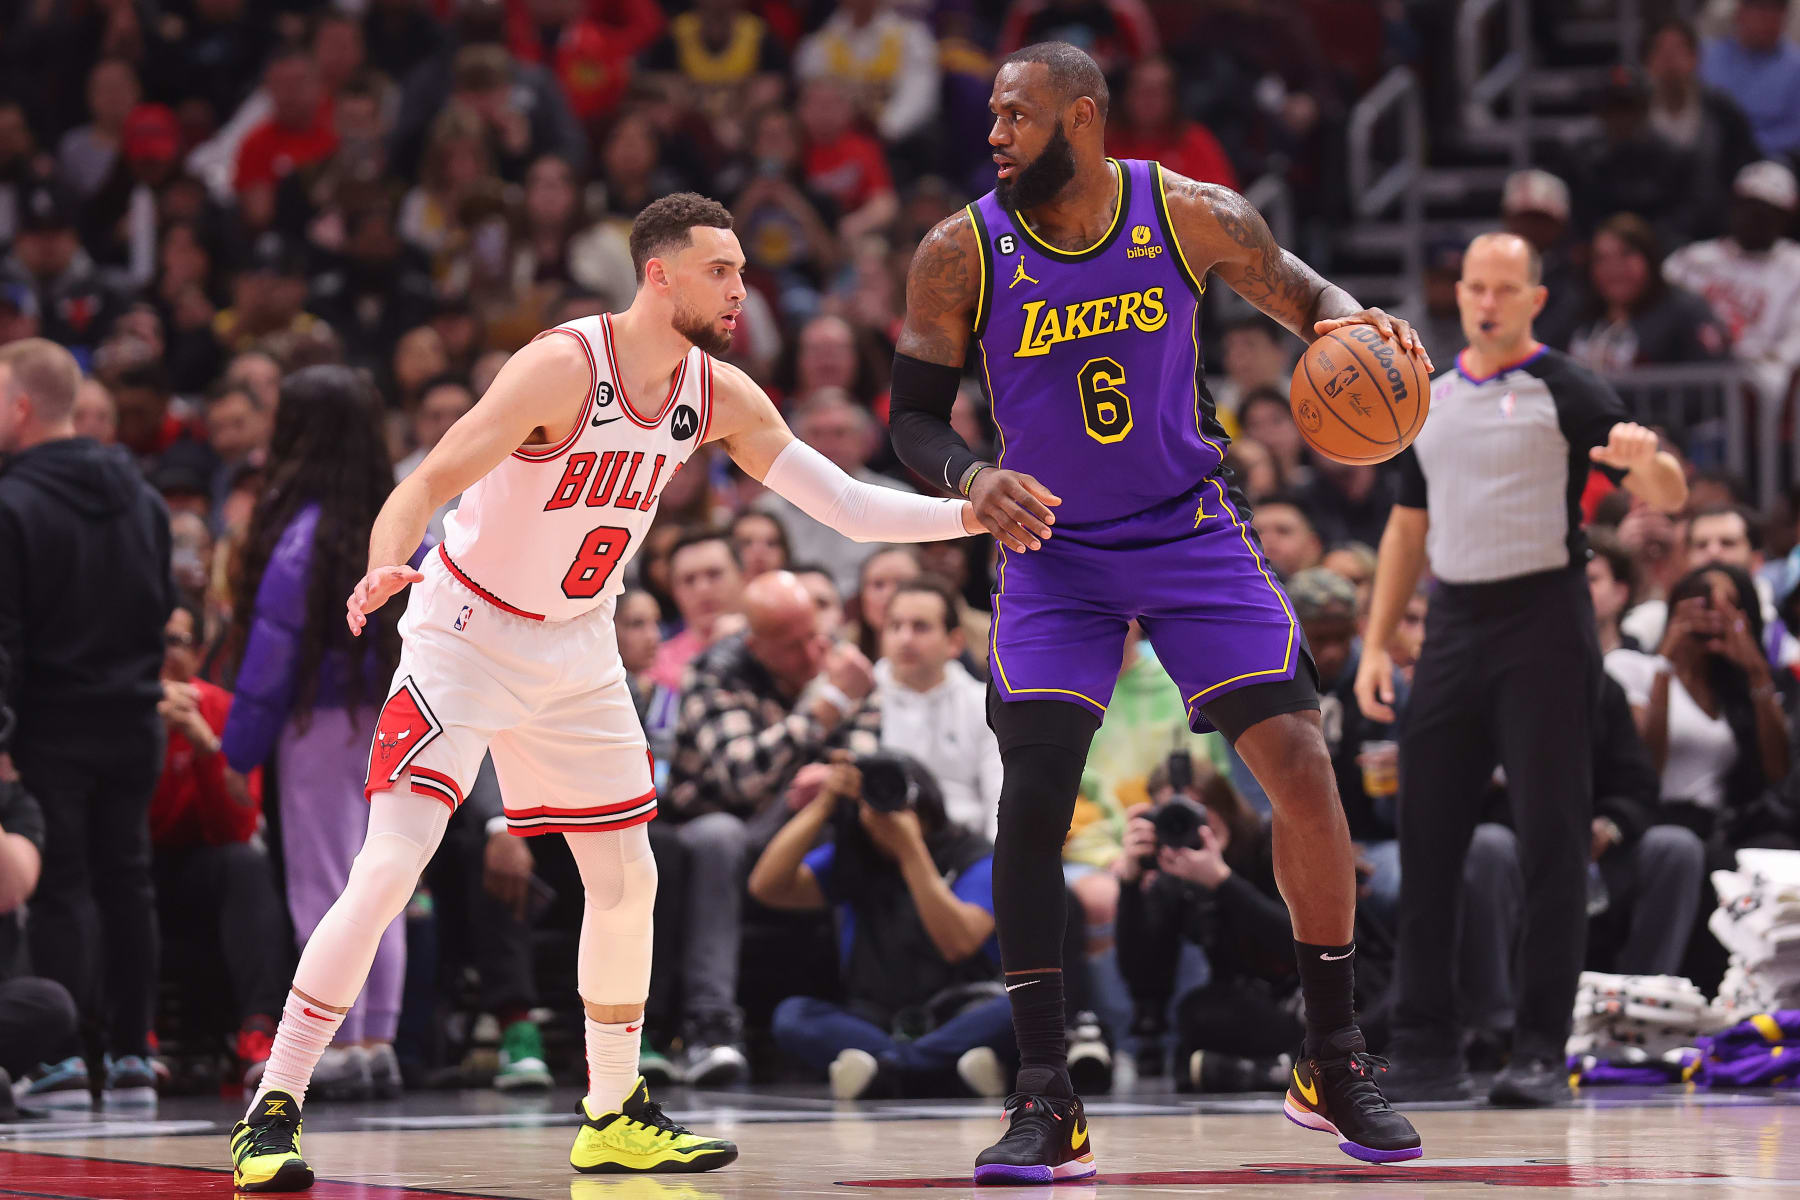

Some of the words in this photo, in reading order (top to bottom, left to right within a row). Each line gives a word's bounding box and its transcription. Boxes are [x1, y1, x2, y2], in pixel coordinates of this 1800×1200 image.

[999, 235, 1015, 254] 6
[1126, 245, 1163, 259] bibigo
[1013, 287, 1169, 358] LAKERS
[598, 385, 609, 404] 6
[1077, 356, 1134, 445] 6
[543, 450, 684, 512] BULL
[561, 526, 632, 599] 8
